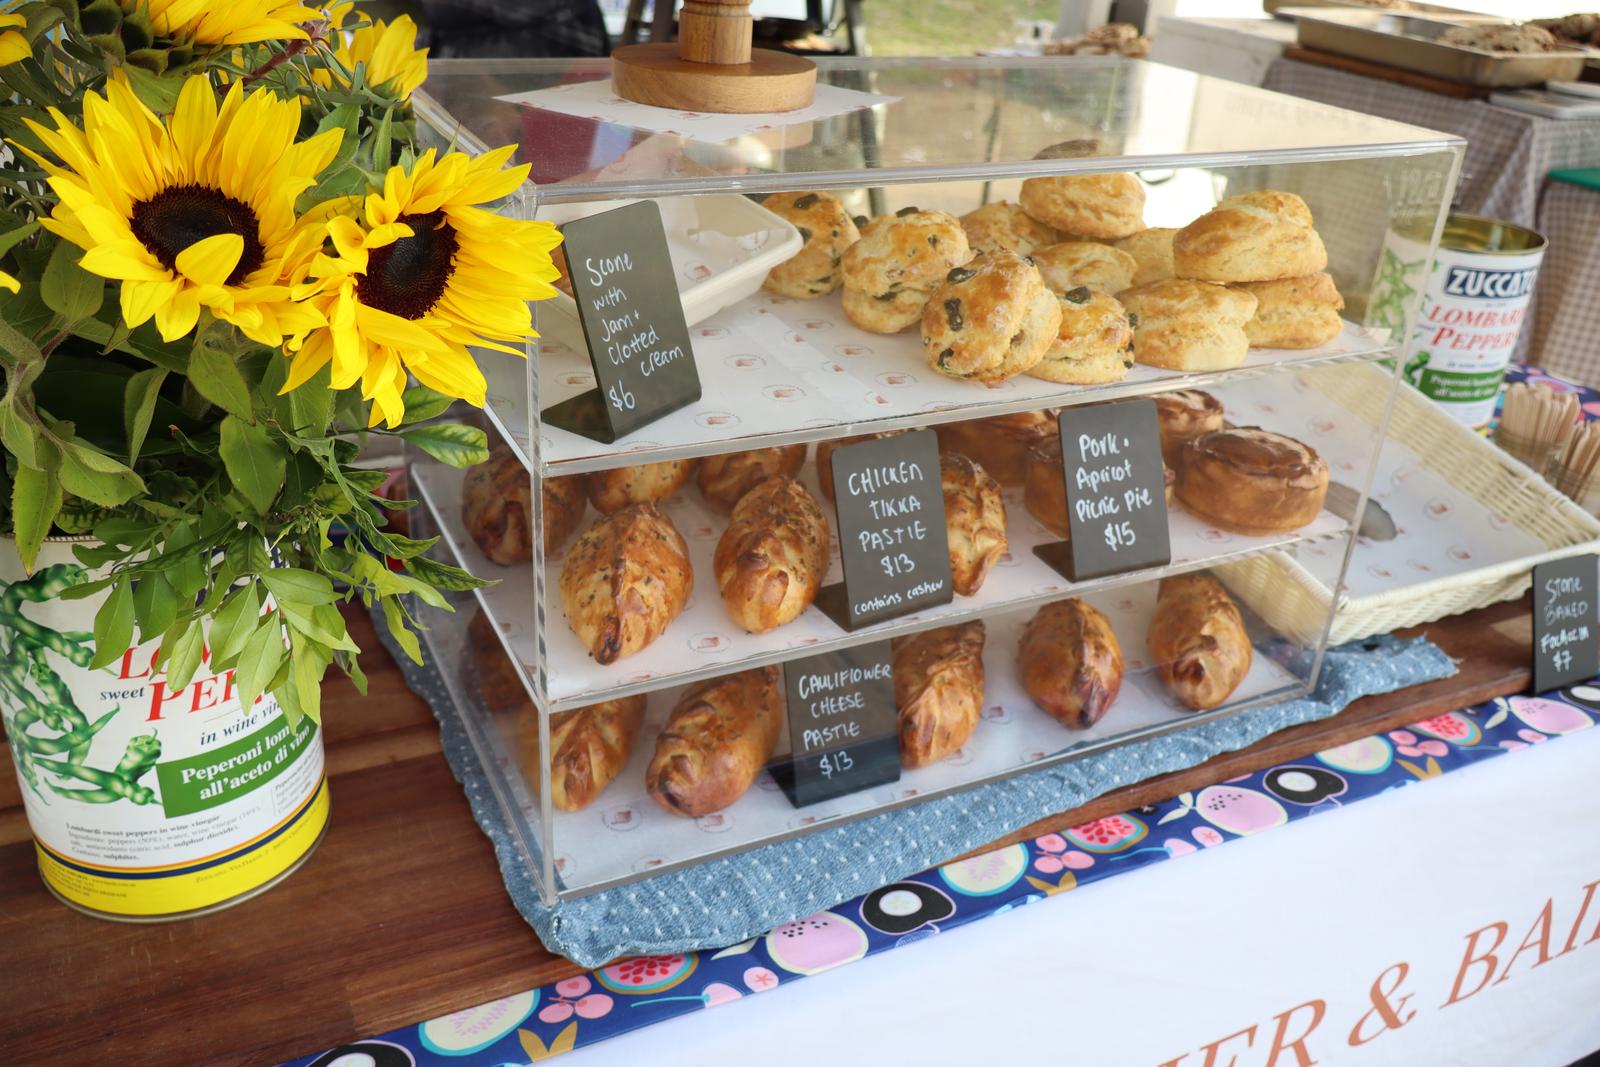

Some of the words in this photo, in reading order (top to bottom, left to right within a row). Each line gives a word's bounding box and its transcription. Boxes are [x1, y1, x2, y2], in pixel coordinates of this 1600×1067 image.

[586, 252, 633, 286] Scone
[593, 286, 627, 311] with
[601, 313, 633, 342] Jam
[608, 323, 661, 365] Clotted
[609, 379, 635, 412] $6
[1076, 459, 1131, 493] Apricot
[869, 496, 921, 520] TIKKA
[1076, 496, 1119, 522] Picnic
[1124, 487, 1152, 512] Pie
[859, 520, 927, 553] PASTIE
[1104, 521, 1136, 551] $15
[881, 553, 915, 577] $13
[854, 593, 902, 615] contains
[907, 579, 943, 600] cashew
[100, 686, 145, 701] sweet
[811, 692, 864, 719] CHEESE
[200, 731, 216, 746] in
[223, 713, 257, 737] wine
[803, 722, 860, 750] PASTIE
[182, 741, 262, 784] Peperoni
[275, 744, 288, 764] di
[820, 751, 853, 780] $13
[1157, 998, 1326, 1067] ER
[1347, 961, 1418, 1047] &
[1438, 879, 1600, 1010] BAI
